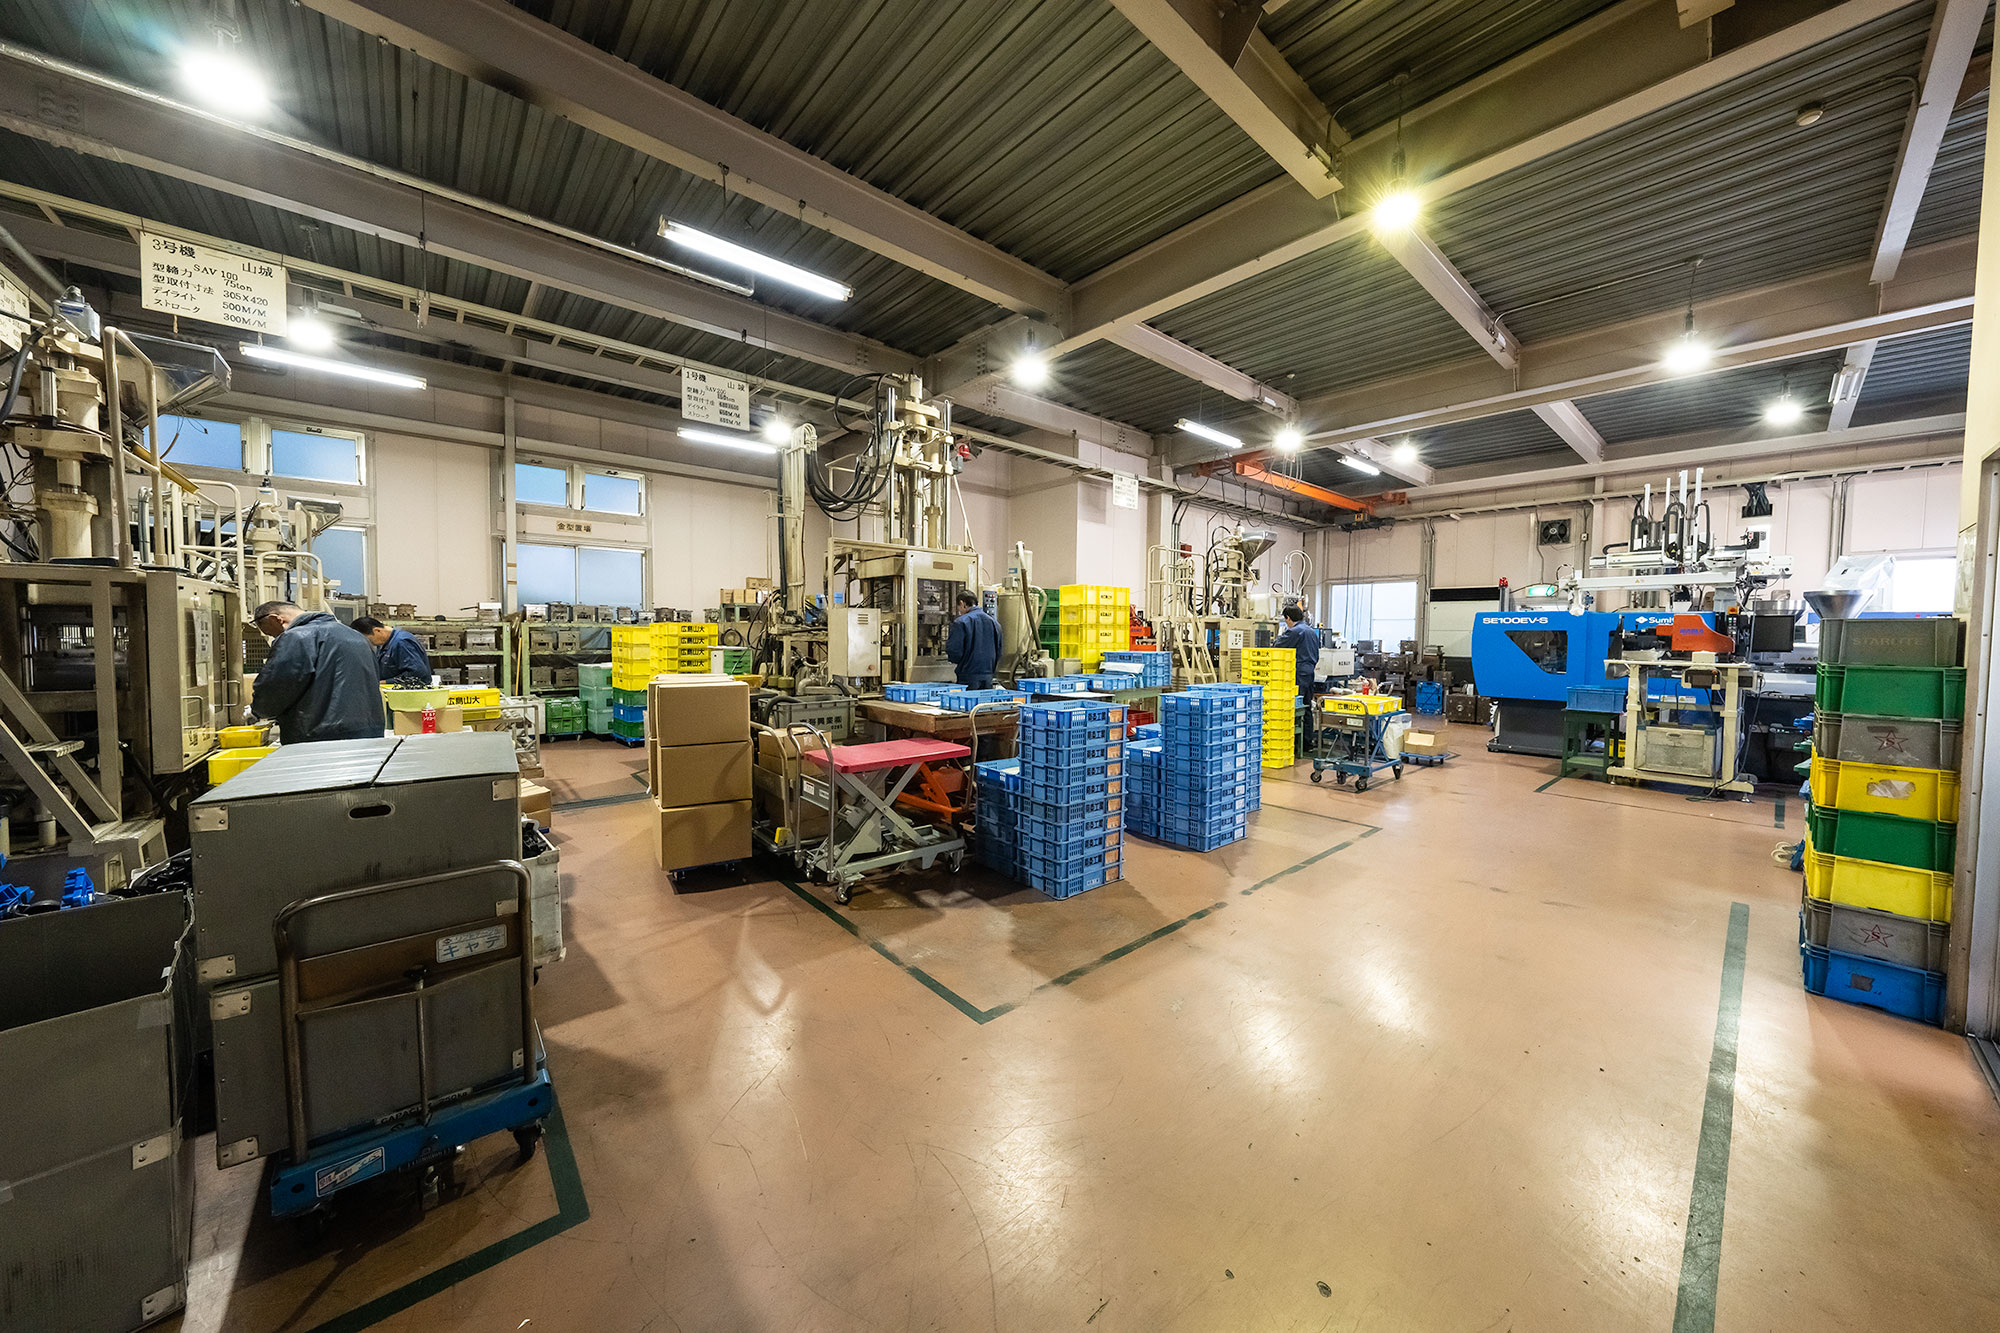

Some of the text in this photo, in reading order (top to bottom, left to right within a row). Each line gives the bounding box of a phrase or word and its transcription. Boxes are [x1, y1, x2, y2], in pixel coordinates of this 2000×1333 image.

[152, 239, 196, 259] 3号機
[193, 264, 238, 281] SAV 100
[242, 262, 274, 278] 山城
[152, 274, 215, 296] 型取付寸法
[223, 278, 253, 292] 75ton
[154, 298, 267, 329] ストローク 300M/M
[222, 302, 267, 318] 500M/M
[1482, 616, 1549, 624] SE100EV-S
[442, 935, 501, 958] キャデ
